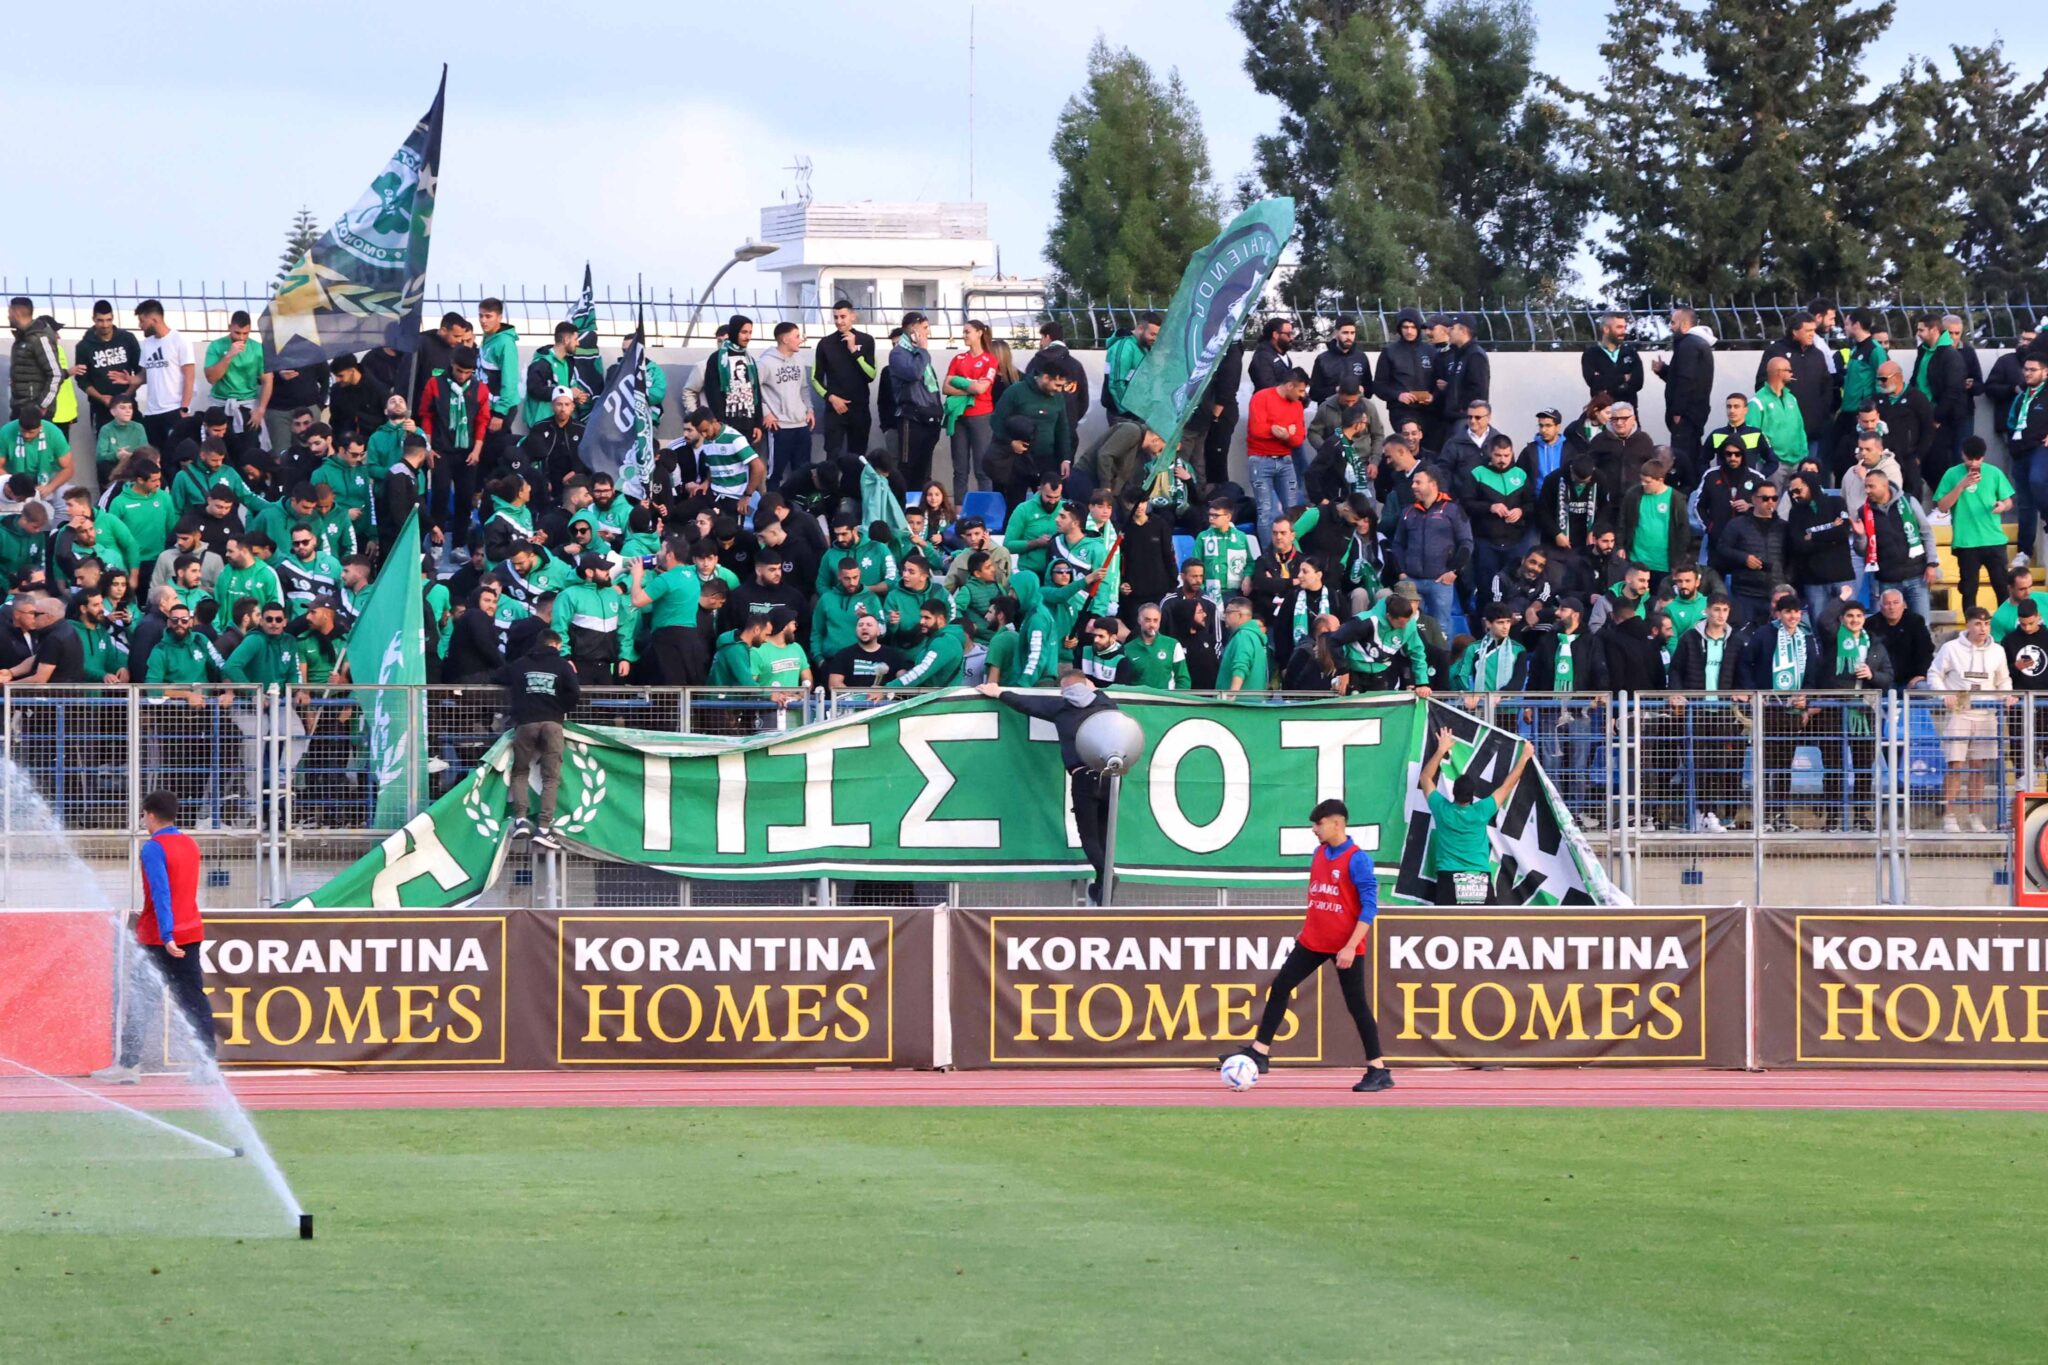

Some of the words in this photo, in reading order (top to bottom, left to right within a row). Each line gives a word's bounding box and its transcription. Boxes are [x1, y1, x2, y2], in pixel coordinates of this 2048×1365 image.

[94, 354, 128, 368] JONES
[575, 938, 876, 972] KORANTINA
[1389, 936, 1689, 970] KORANTINA
[1812, 937, 2048, 972] KORANTI
[581, 983, 870, 1043] HOMES
[1396, 982, 1683, 1041] HOMES
